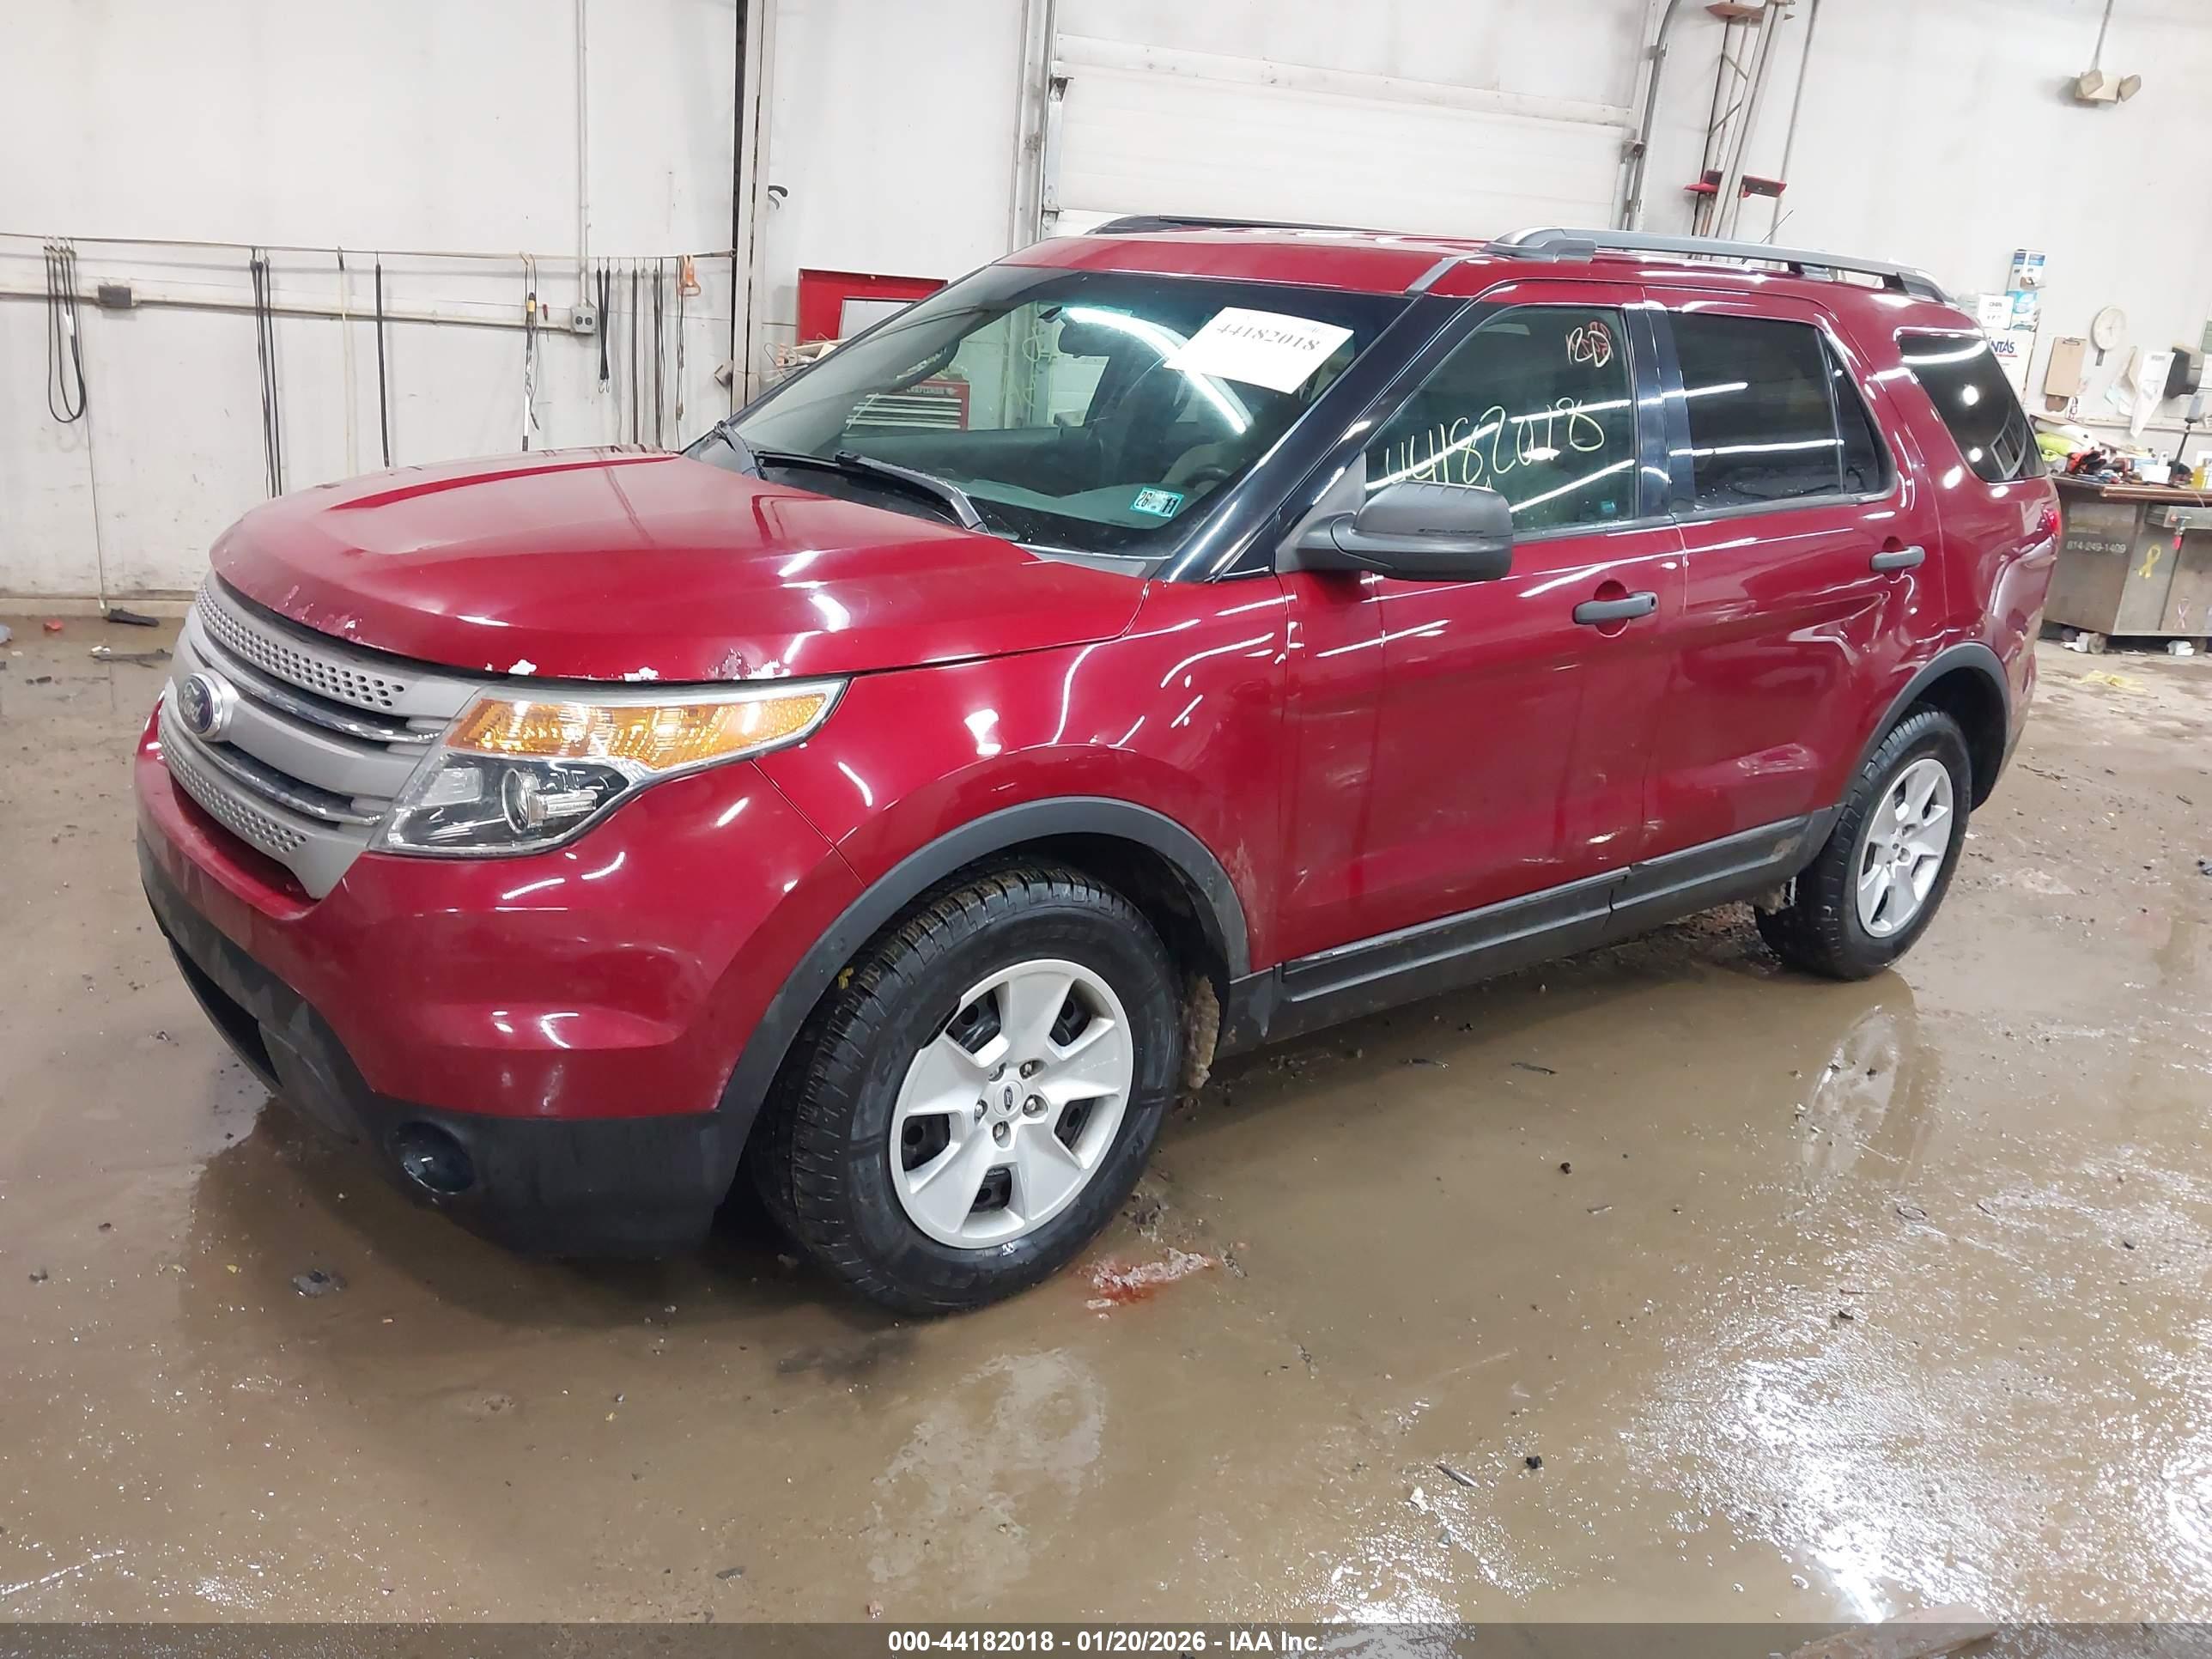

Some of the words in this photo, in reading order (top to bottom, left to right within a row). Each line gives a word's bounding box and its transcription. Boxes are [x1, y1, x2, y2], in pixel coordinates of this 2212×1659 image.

[1216, 323, 1321, 351] 44182018
[1385, 397, 1606, 483] 44182018
[1135, 491, 1153, 507] 26
[1162, 497, 1179, 514] 11
[179, 680, 205, 724] Ford
